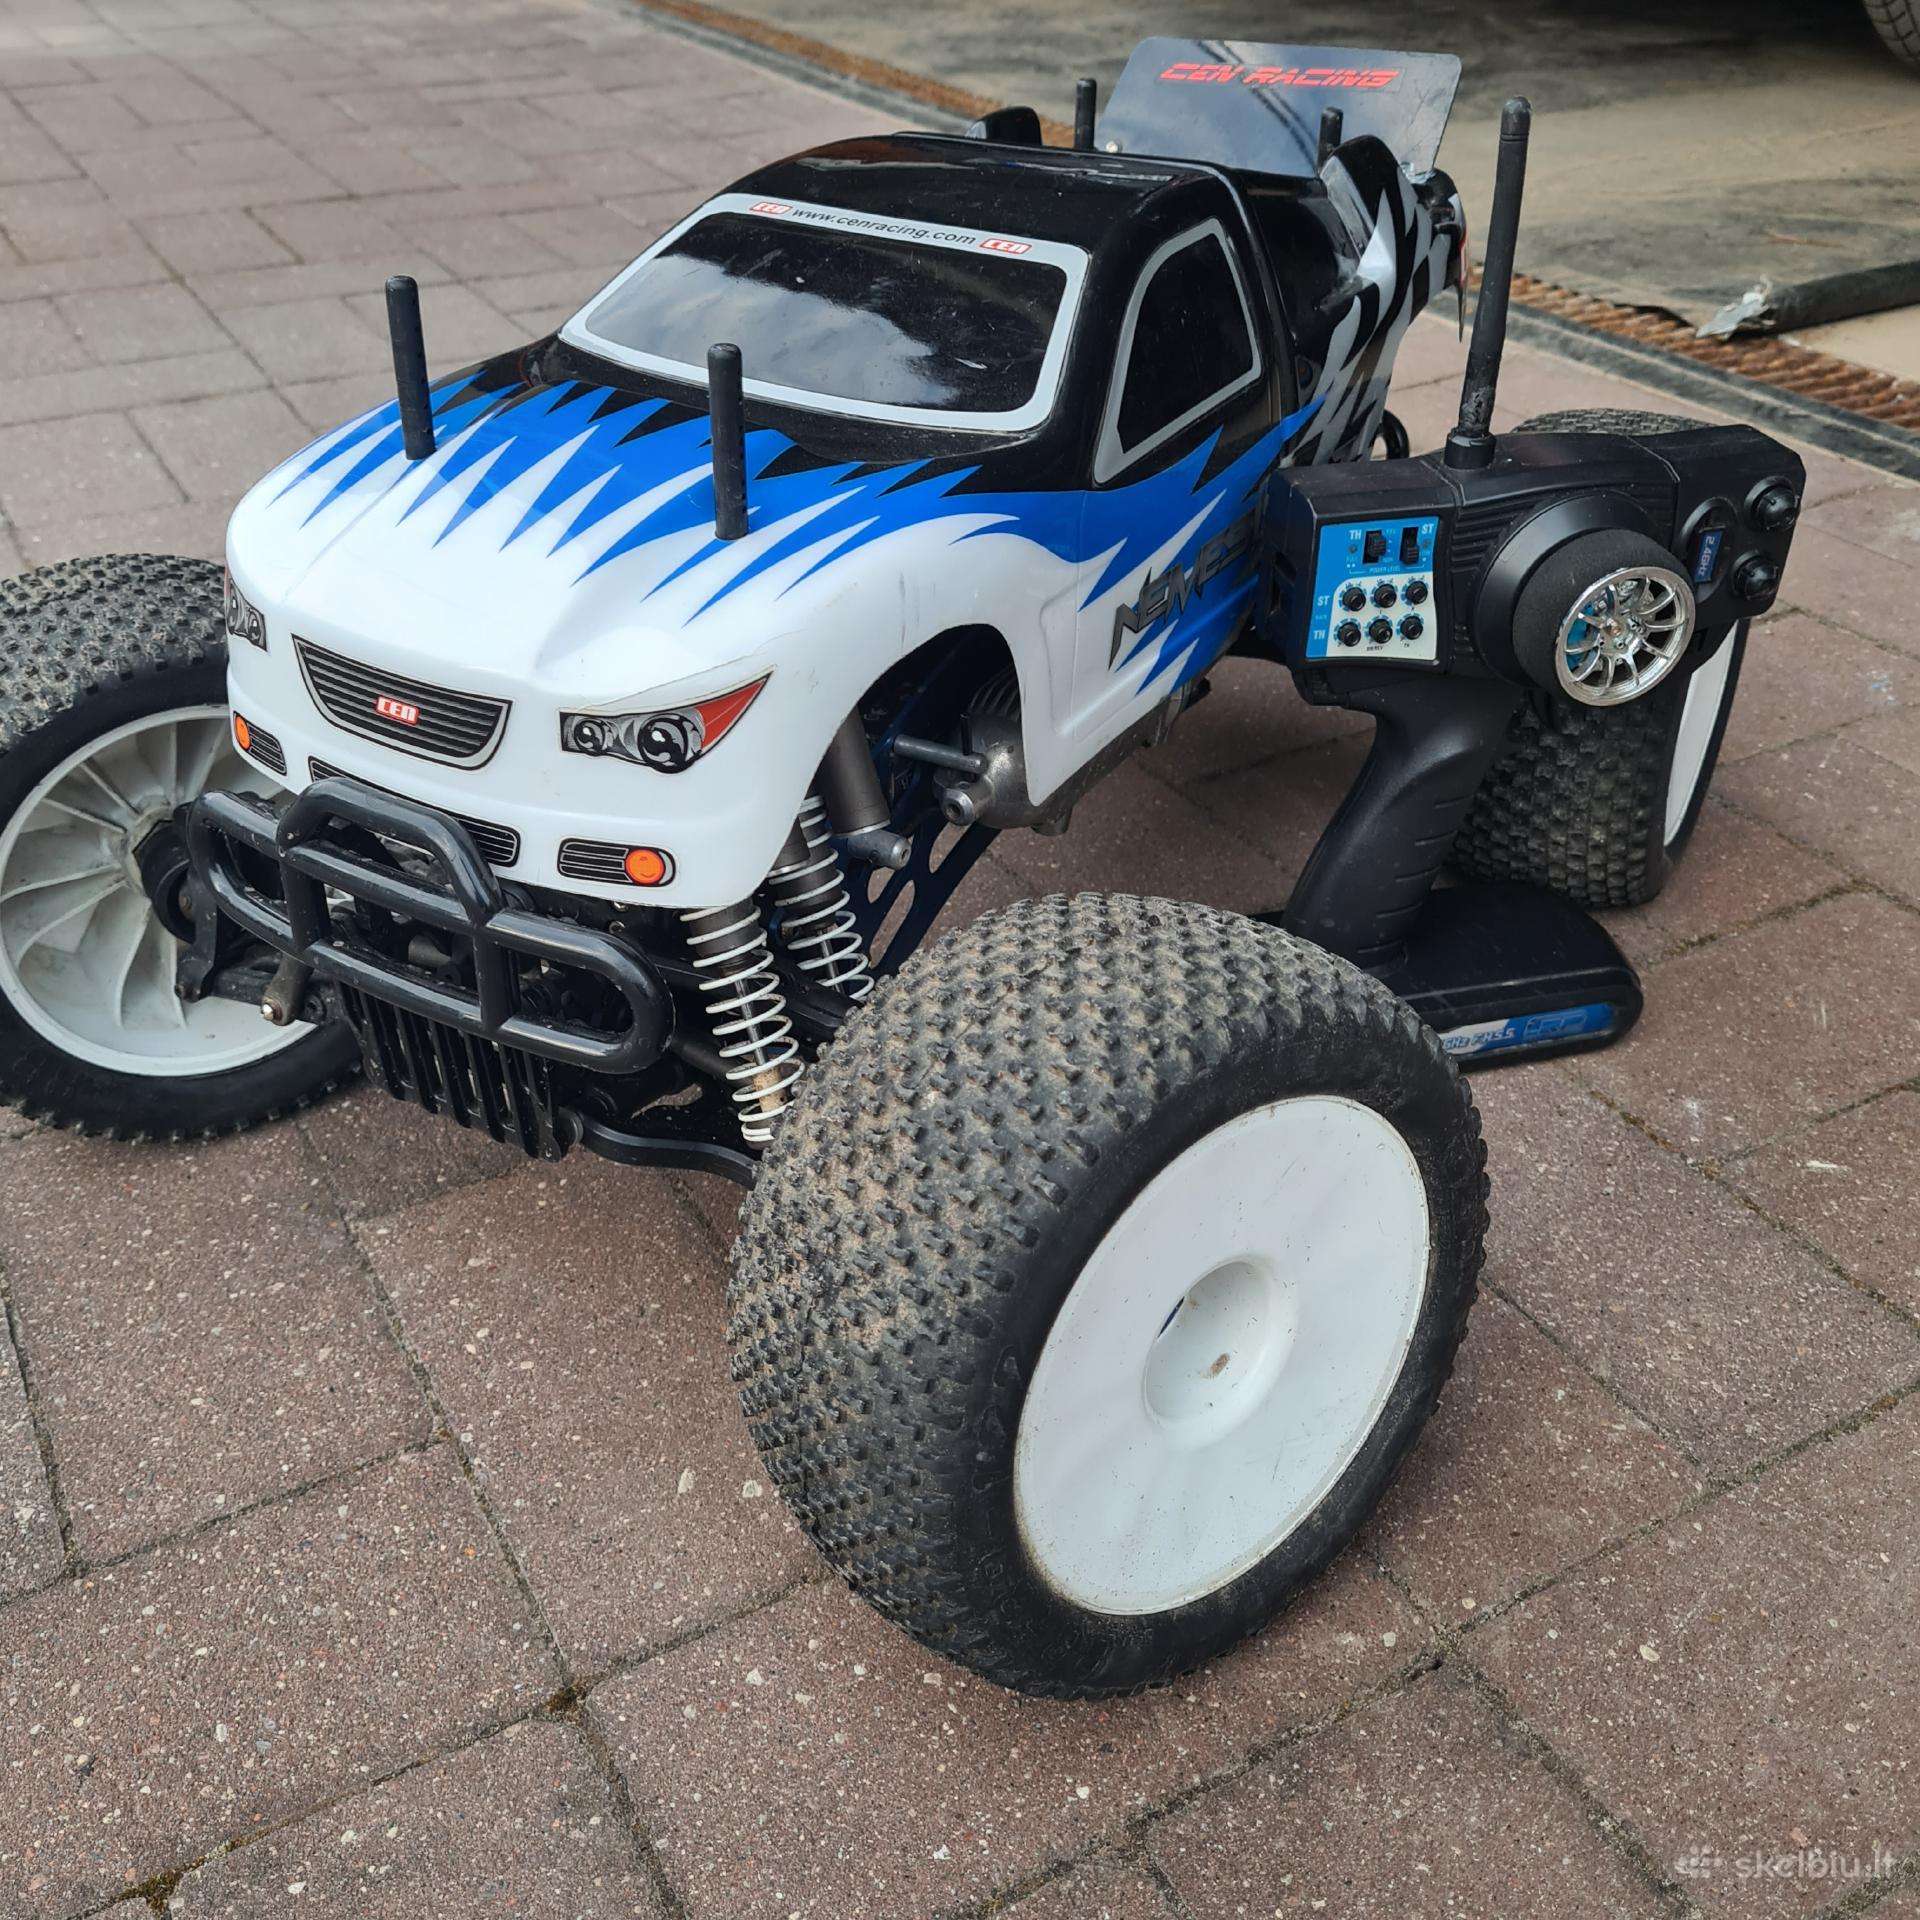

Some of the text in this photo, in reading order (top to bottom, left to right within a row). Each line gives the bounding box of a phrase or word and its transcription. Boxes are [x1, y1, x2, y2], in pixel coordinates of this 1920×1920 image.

[1160, 63, 1399, 89] CEN RACING
[792, 208, 977, 246] www.cenracing.com
[981, 239, 1031, 254] CEN
[1350, 530, 1362, 540] TH
[1422, 523, 1434, 534] ST
[1317, 595, 1330, 606] ST
[377, 696, 418, 723] CEN
